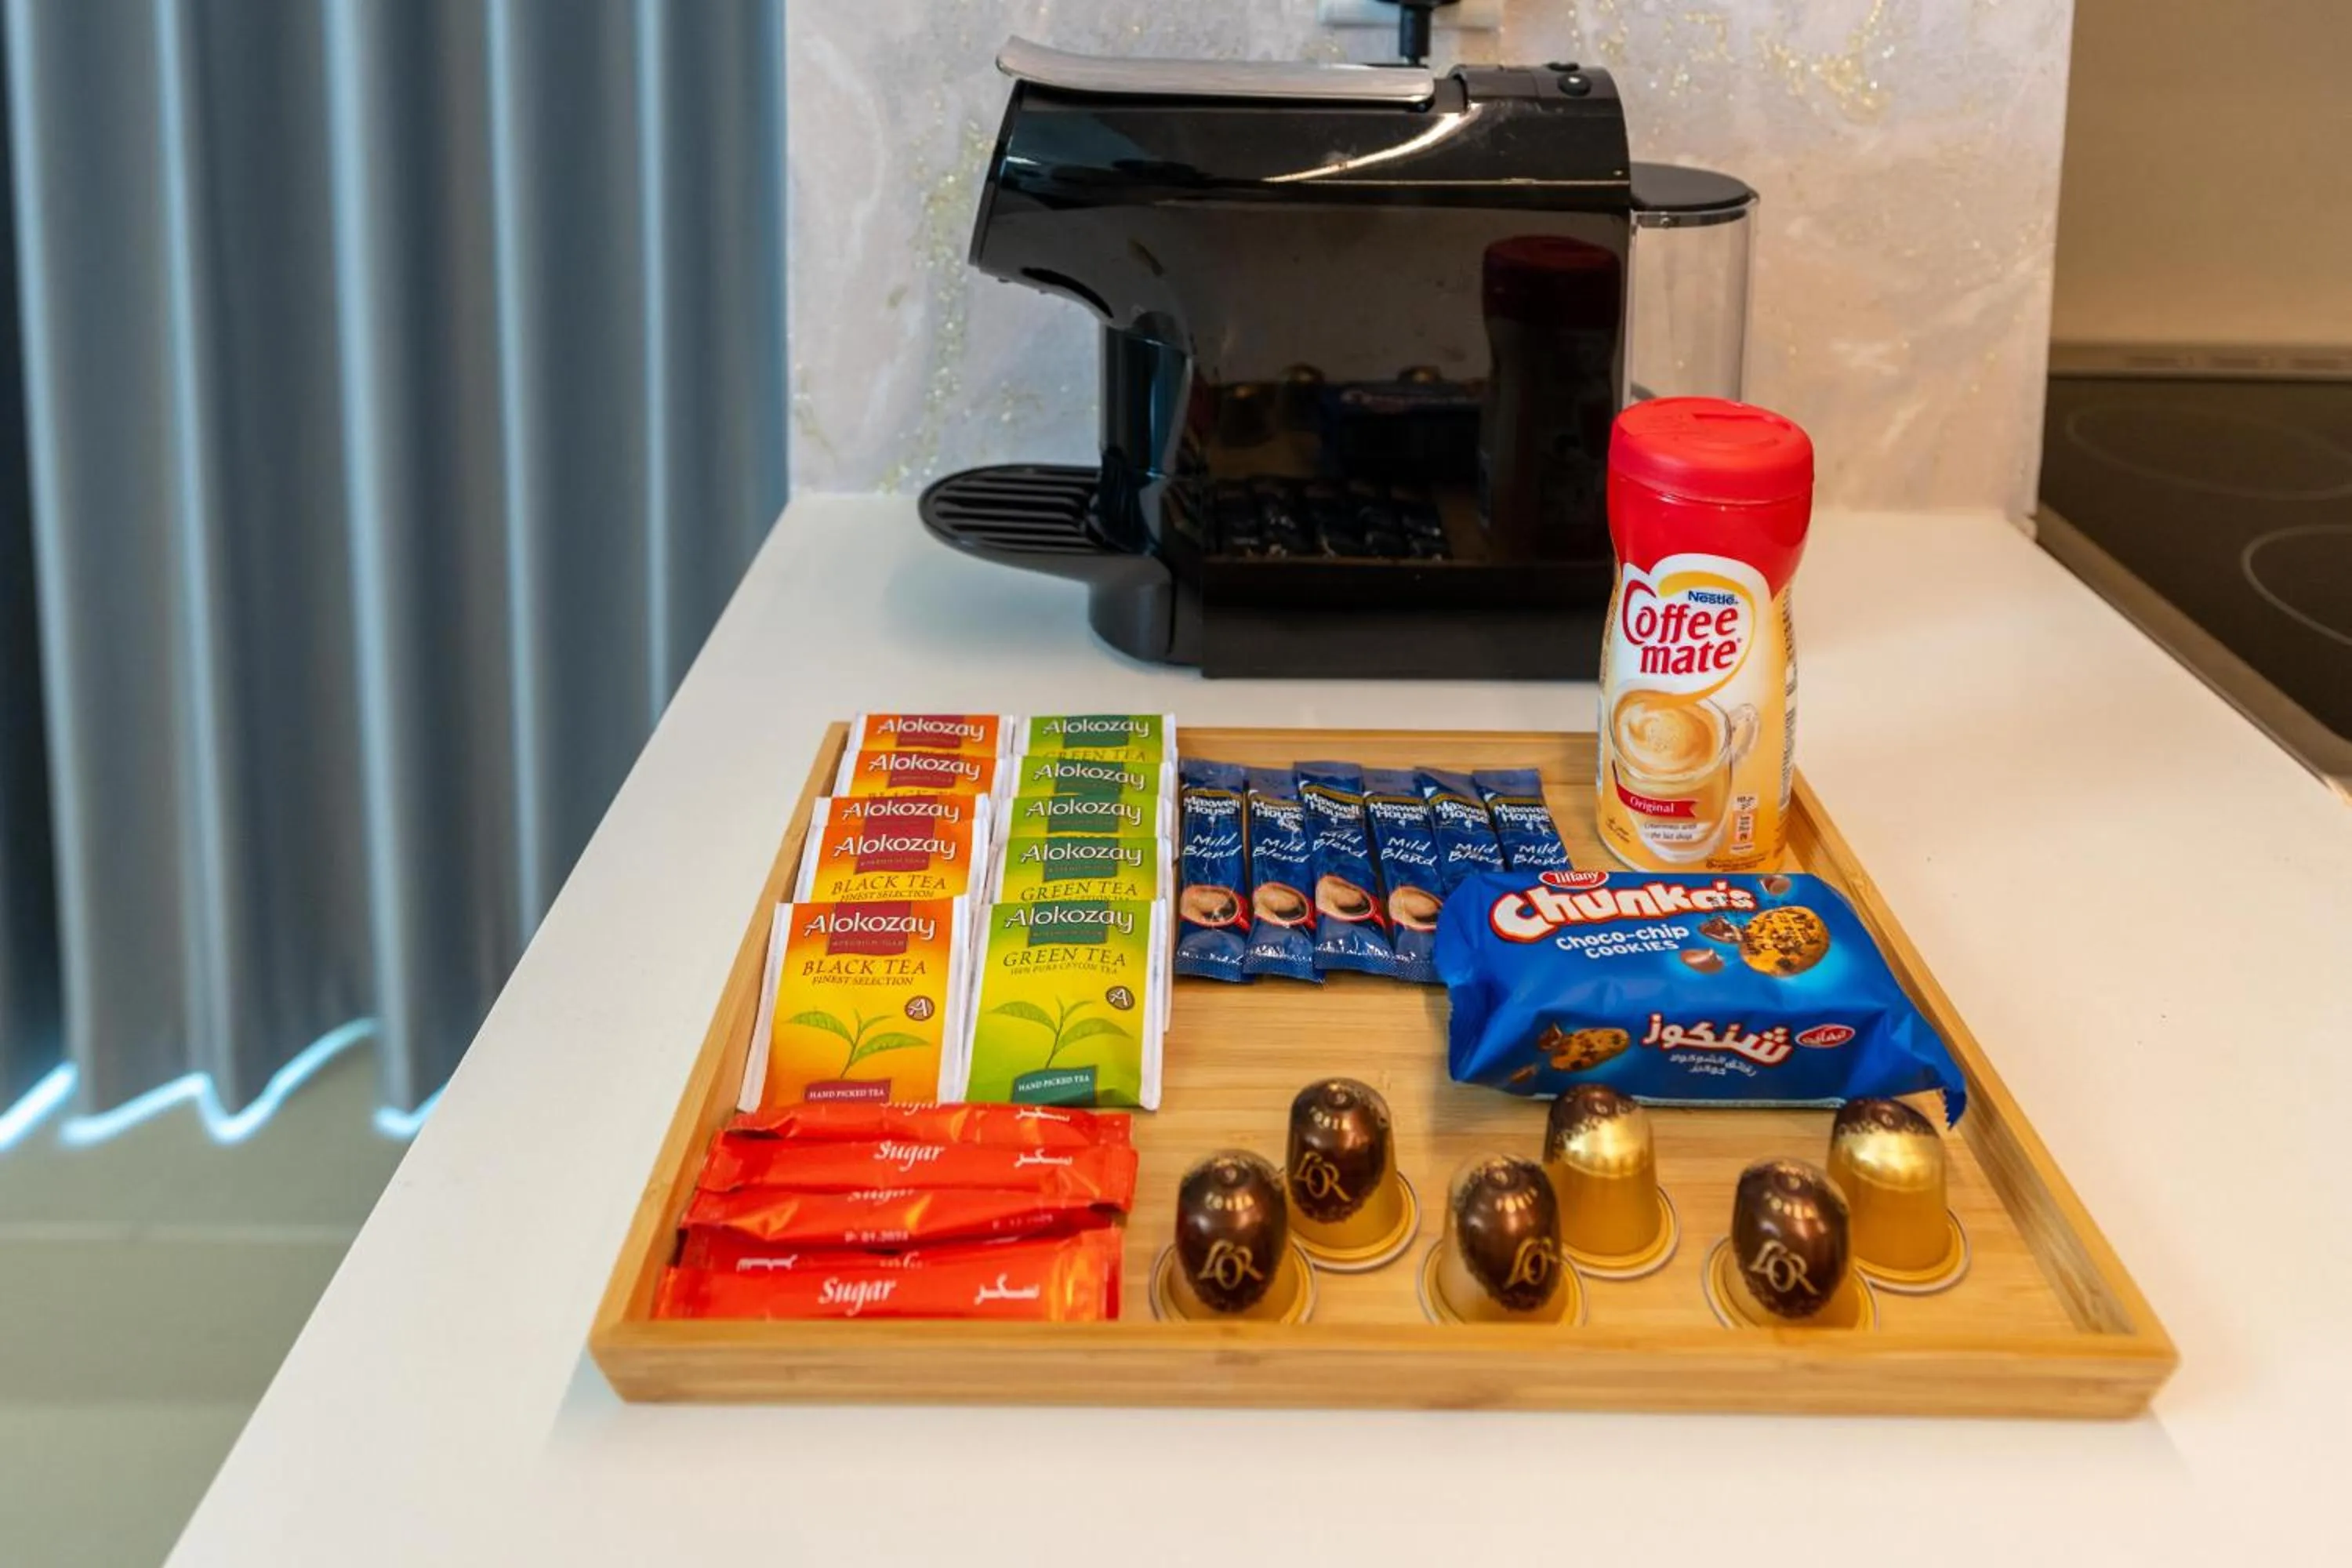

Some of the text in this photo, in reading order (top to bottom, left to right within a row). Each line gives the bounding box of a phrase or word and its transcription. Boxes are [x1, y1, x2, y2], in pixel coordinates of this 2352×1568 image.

[1622, 579, 1739, 645] Coffee
[1639, 640, 1737, 675] mate
[877, 717, 985, 742] Alokozay
[1041, 718, 1150, 738] Alokozay
[868, 753, 981, 781] Alokozay
[1033, 762, 1145, 790] Alokozay
[841, 800, 960, 823] Alokozay
[1025, 798, 1142, 826] Alokozay
[1187, 804, 1236, 815] House
[1304, 793, 1360, 815] Maxwell
[1309, 801, 1356, 820] House
[1370, 802, 1429, 816] Maxwell
[1630, 796, 1675, 814] Original
[1256, 808, 1305, 821] House
[1375, 810, 1425, 821] House
[1442, 810, 1489, 825] House
[1501, 813, 1551, 822] House
[833, 834, 957, 860] Alokozay
[1192, 832, 1238, 848] Mild
[1261, 838, 1307, 852] Mild
[1319, 831, 1363, 844] Mild
[1387, 837, 1431, 852] Mild
[1021, 843, 1143, 866] Alokozay
[1182, 844, 1243, 859] Blend
[1253, 846, 1311, 863] Blend
[1312, 838, 1368, 858] Blend
[1380, 848, 1438, 866] Blend
[1454, 844, 1498, 855] Mild
[1519, 841, 1563, 855] Mild
[1512, 854, 1569, 866] Blend
[831, 874, 947, 895] BLACK TEA
[1020, 880, 1138, 902] GREEN TEA
[804, 912, 936, 941] Alokozay
[1005, 906, 1134, 935] Alokozay
[1003, 947, 1127, 967] GREEN TEA
[1585, 940, 1679, 959] COOKIES
[803, 959, 927, 976] BLACK TEA
[812, 975, 914, 985] FINEST SELECTION
[809, 1087, 886, 1099] HAND PICKED TEA
[1018, 1074, 1091, 1093] HAND PICKED TEA
[873, 1139, 947, 1173] Sugar
[1014, 1148, 1073, 1168] سكر
[818, 1276, 897, 1317] Sugar
[974, 1272, 1040, 1306] سكر
